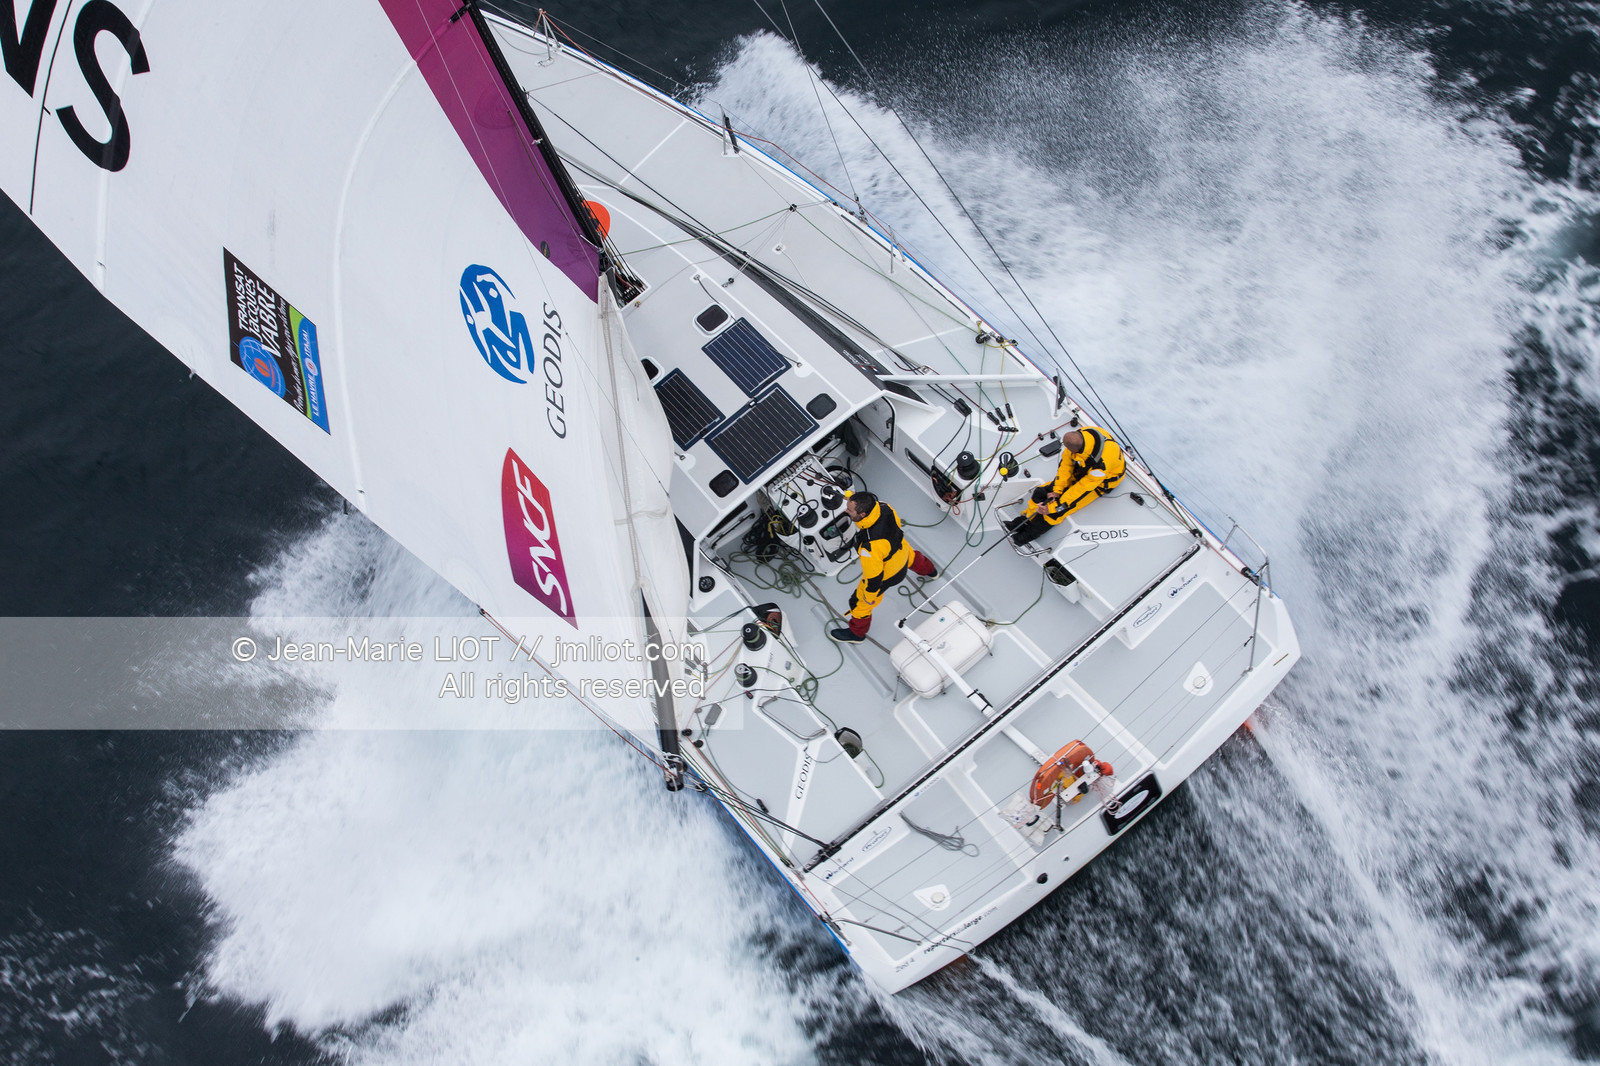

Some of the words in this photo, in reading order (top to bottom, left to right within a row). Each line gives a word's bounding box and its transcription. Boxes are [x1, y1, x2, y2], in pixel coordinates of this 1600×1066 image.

[233, 262, 248, 331] TRANSAT
[256, 280, 281, 357] VABRE
[307, 373, 317, 404] HAVRE
[543, 302, 567, 439] GEODIS
[311, 403, 319, 416] LE
[511, 458, 568, 616] SNCF
[1080, 529, 1129, 542] GEODIS
[795, 755, 812, 800] GEODIS
